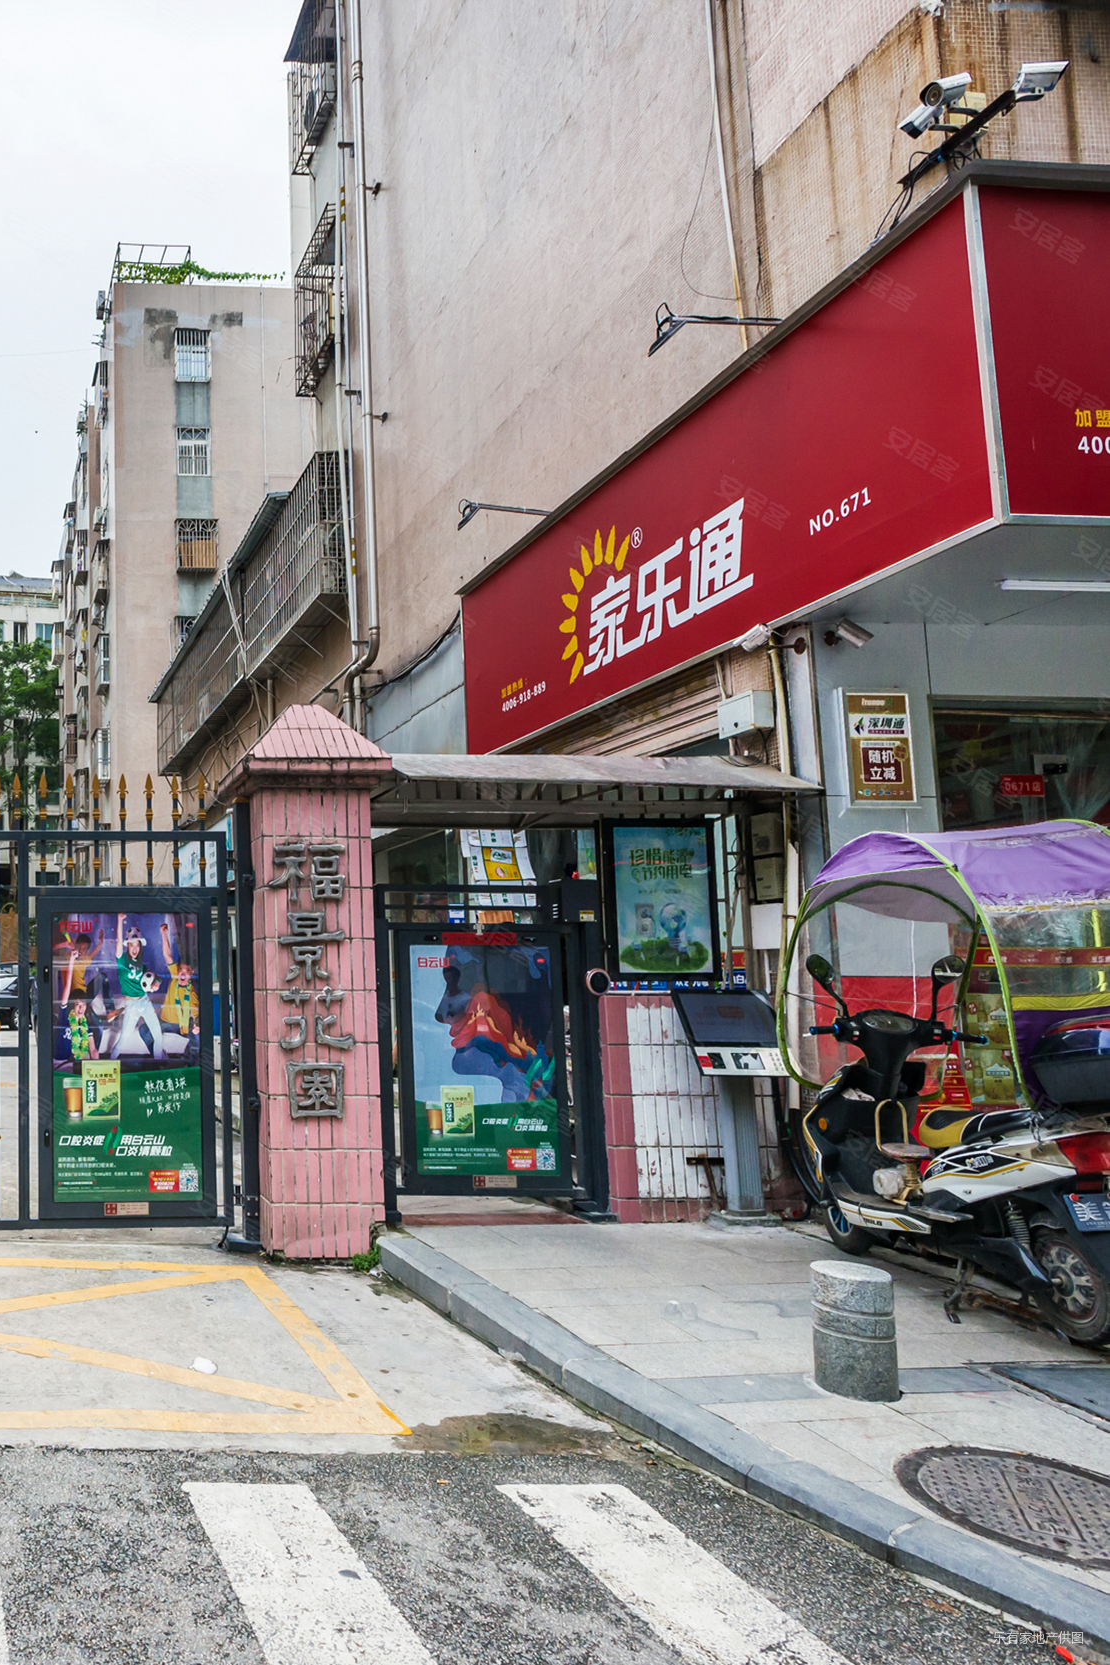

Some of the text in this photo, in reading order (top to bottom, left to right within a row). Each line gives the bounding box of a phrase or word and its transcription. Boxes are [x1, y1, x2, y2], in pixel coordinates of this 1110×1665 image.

[808, 486, 872, 536] NO.671
[583, 497, 754, 676] 家乐通
[502, 680, 546, 712] 4006-918-889
[867, 717, 905, 729] 深圳通
[868, 750, 895, 764] 随机
[870, 766, 896, 780] 立减
[1005, 781, 1041, 792] 0671店
[630, 848, 692, 867] 珍惜能源
[642, 864, 692, 881] 节约用电
[59, 921, 92, 933] 白云山
[417, 956, 450, 968] 白云山
[58, 1134, 166, 1146] 口腔炎症 用白云山
[115, 1146, 173, 1157] 口炎清颗粒
